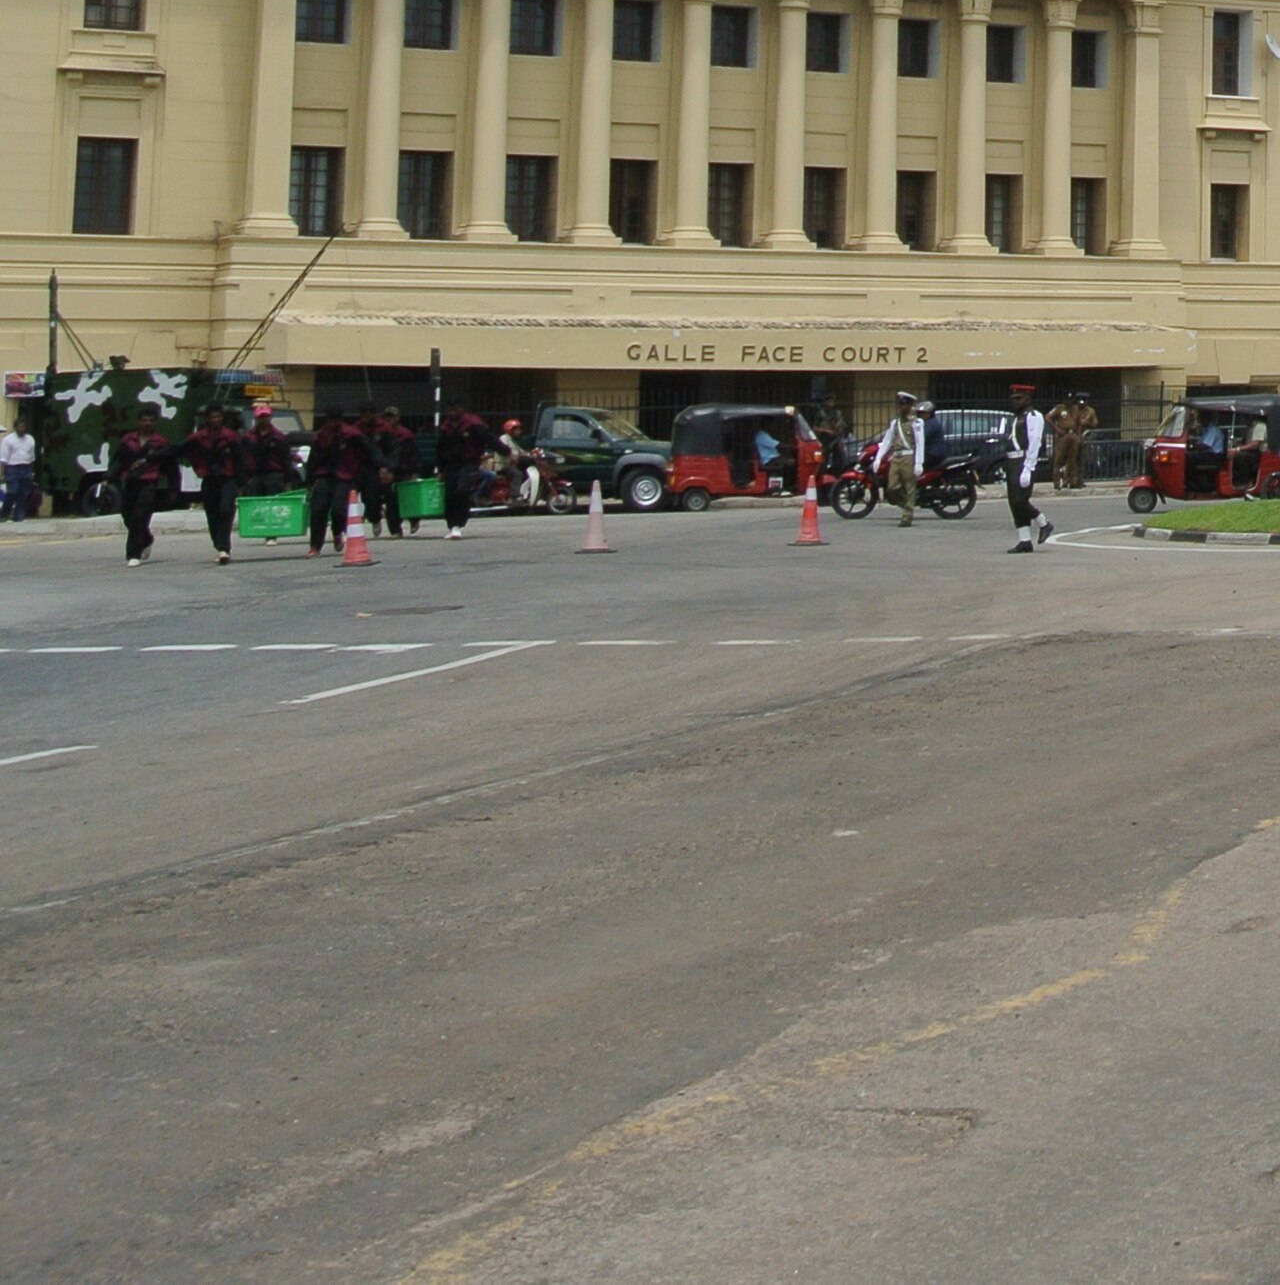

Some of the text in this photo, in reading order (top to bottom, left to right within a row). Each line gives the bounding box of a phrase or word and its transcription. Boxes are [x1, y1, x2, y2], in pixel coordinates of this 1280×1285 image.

[626, 344, 928, 364] GALLE FACE COURT 2
